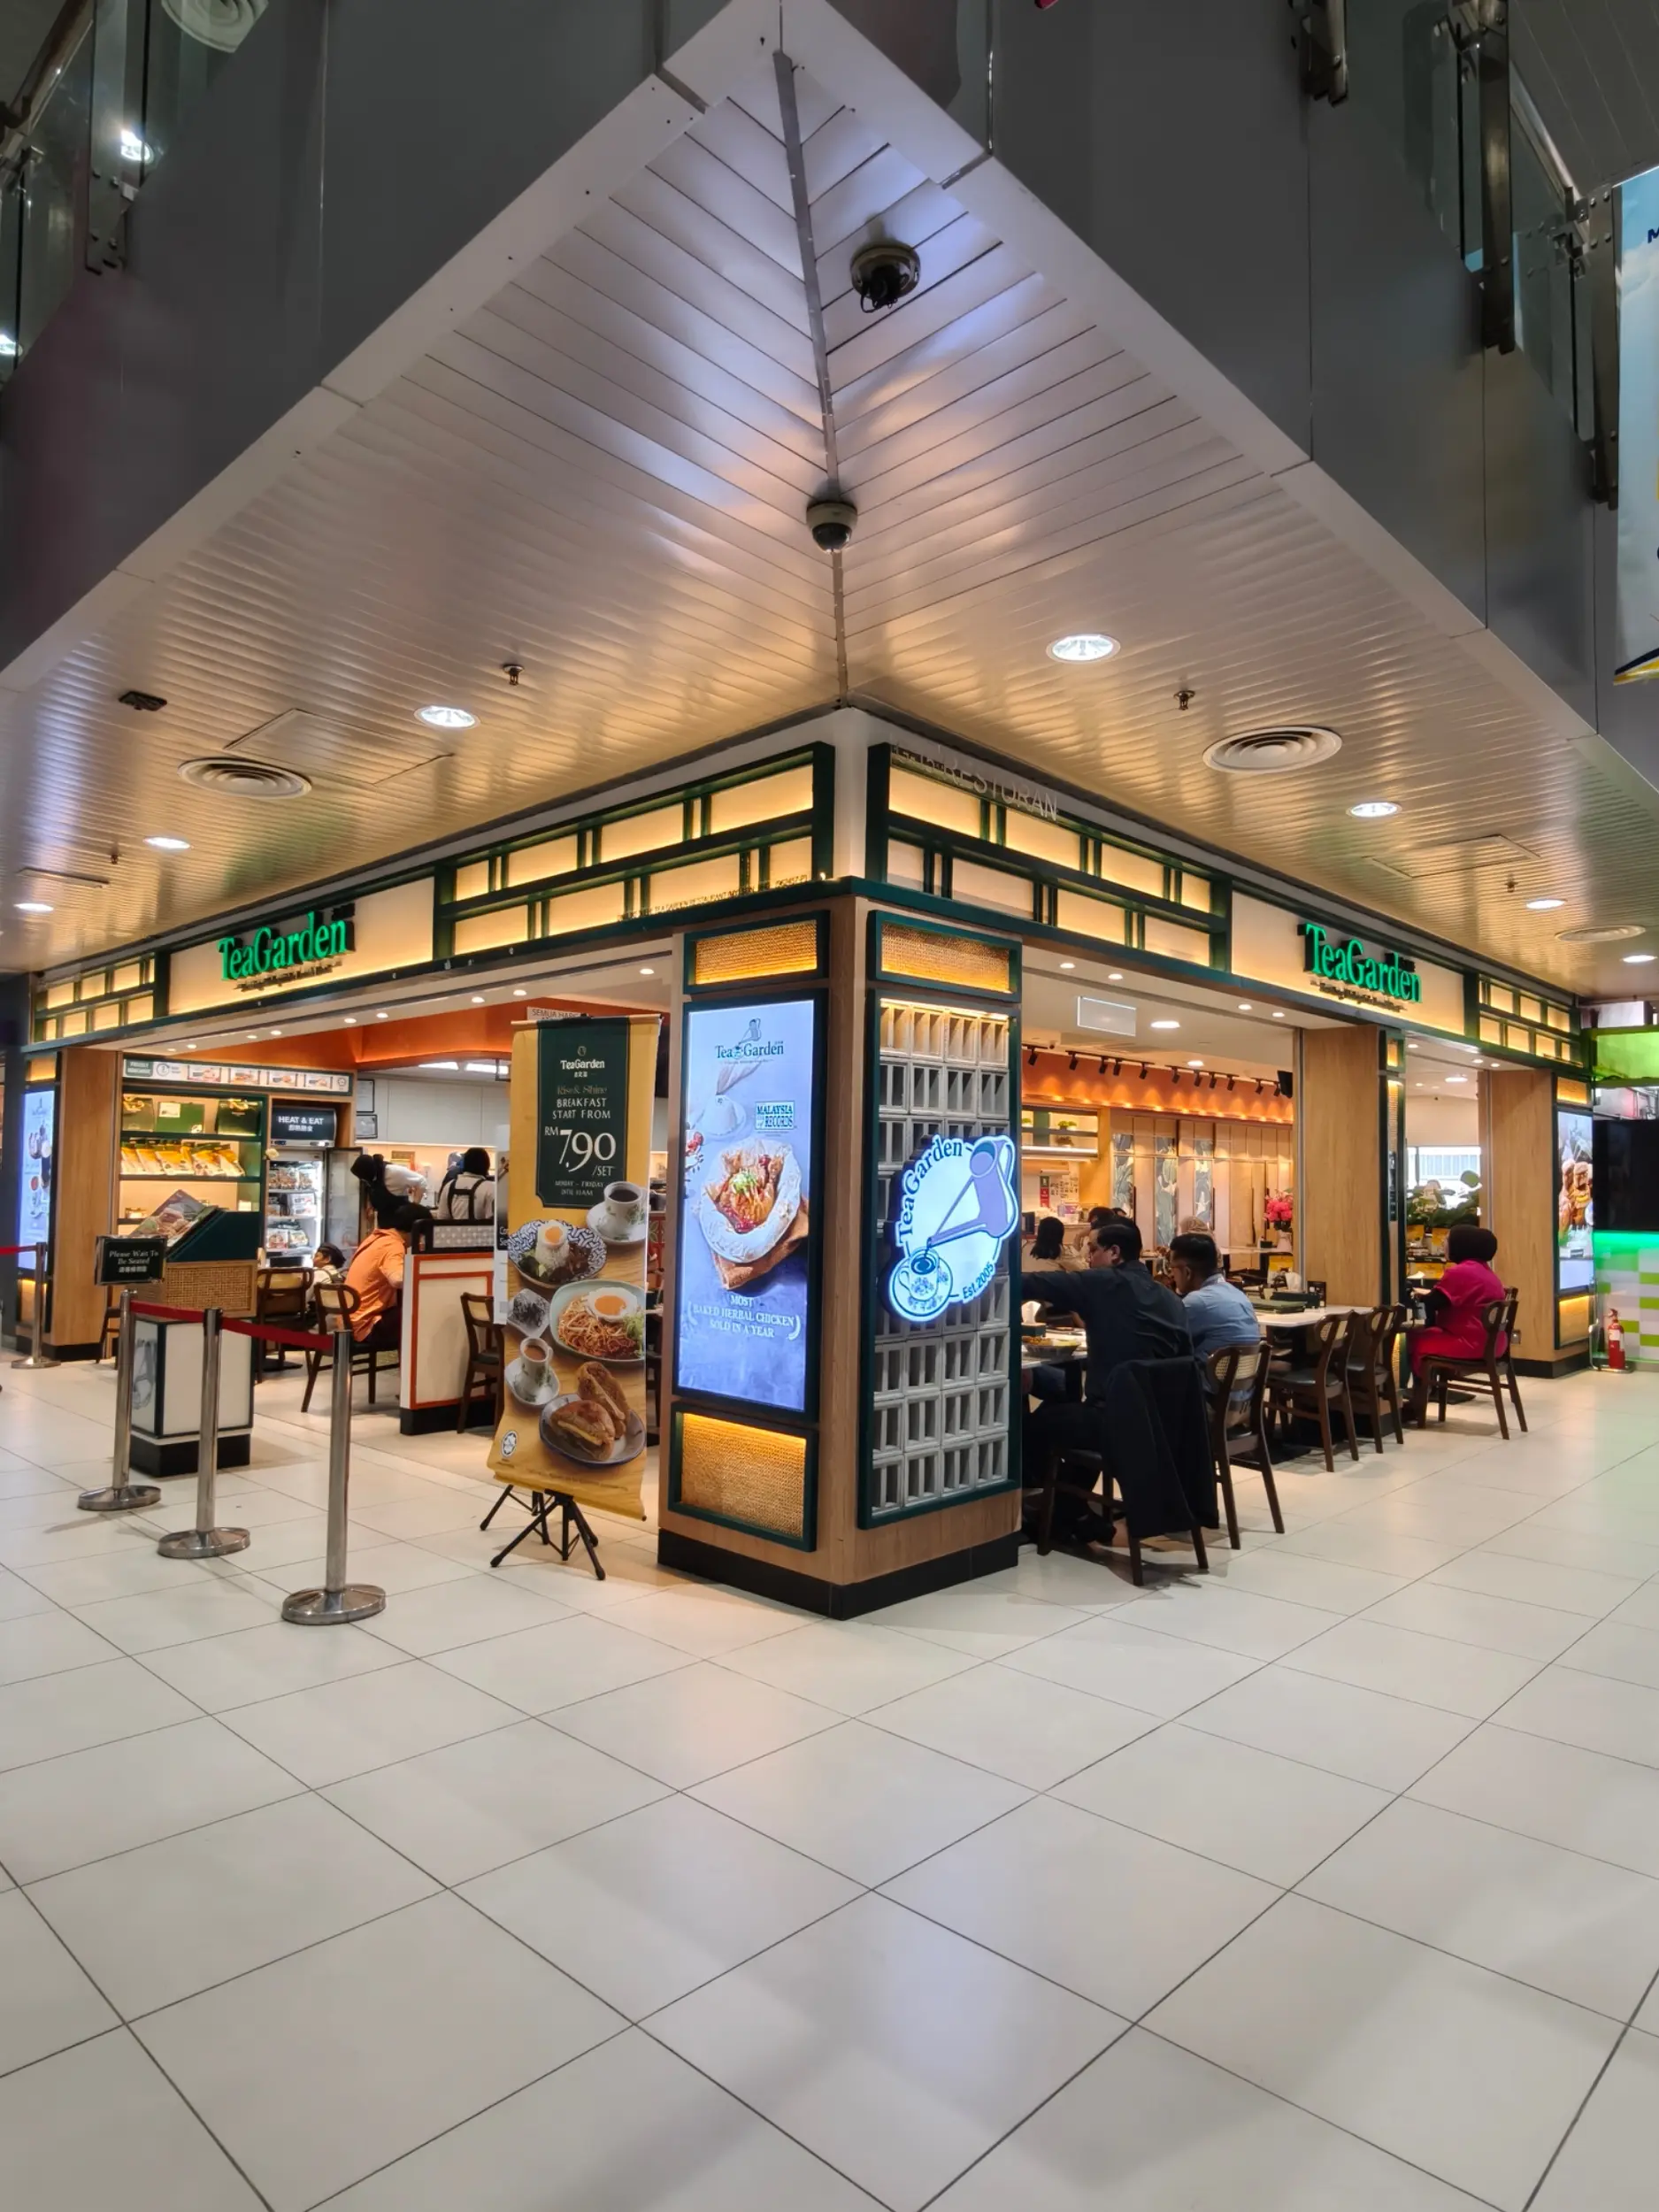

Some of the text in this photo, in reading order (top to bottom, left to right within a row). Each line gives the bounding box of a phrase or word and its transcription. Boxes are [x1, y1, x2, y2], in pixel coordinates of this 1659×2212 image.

[217, 910, 348, 981] TeaGarden
[1304, 921, 1423, 1003] TeaGarden
[715, 1041, 784, 1058] Tea Garden
[559, 1059, 605, 1070] TeaGarden
[557, 1097, 608, 1108] BREAKFAST
[757, 1104, 793, 1115] MALAYSIA
[278, 1116, 299, 1125] HEAT
[552, 1110, 611, 1119] START FROM
[544, 1126, 617, 1177] RM 7.90 /SET
[897, 1136, 963, 1245] TeaGarden
[730, 1295, 754, 1308] MOST
[693, 1304, 795, 1326] BAKED HERBAL CHICKEN
[710, 1319, 731, 1332] SOLD
[751, 1326, 775, 1338] YEAR
